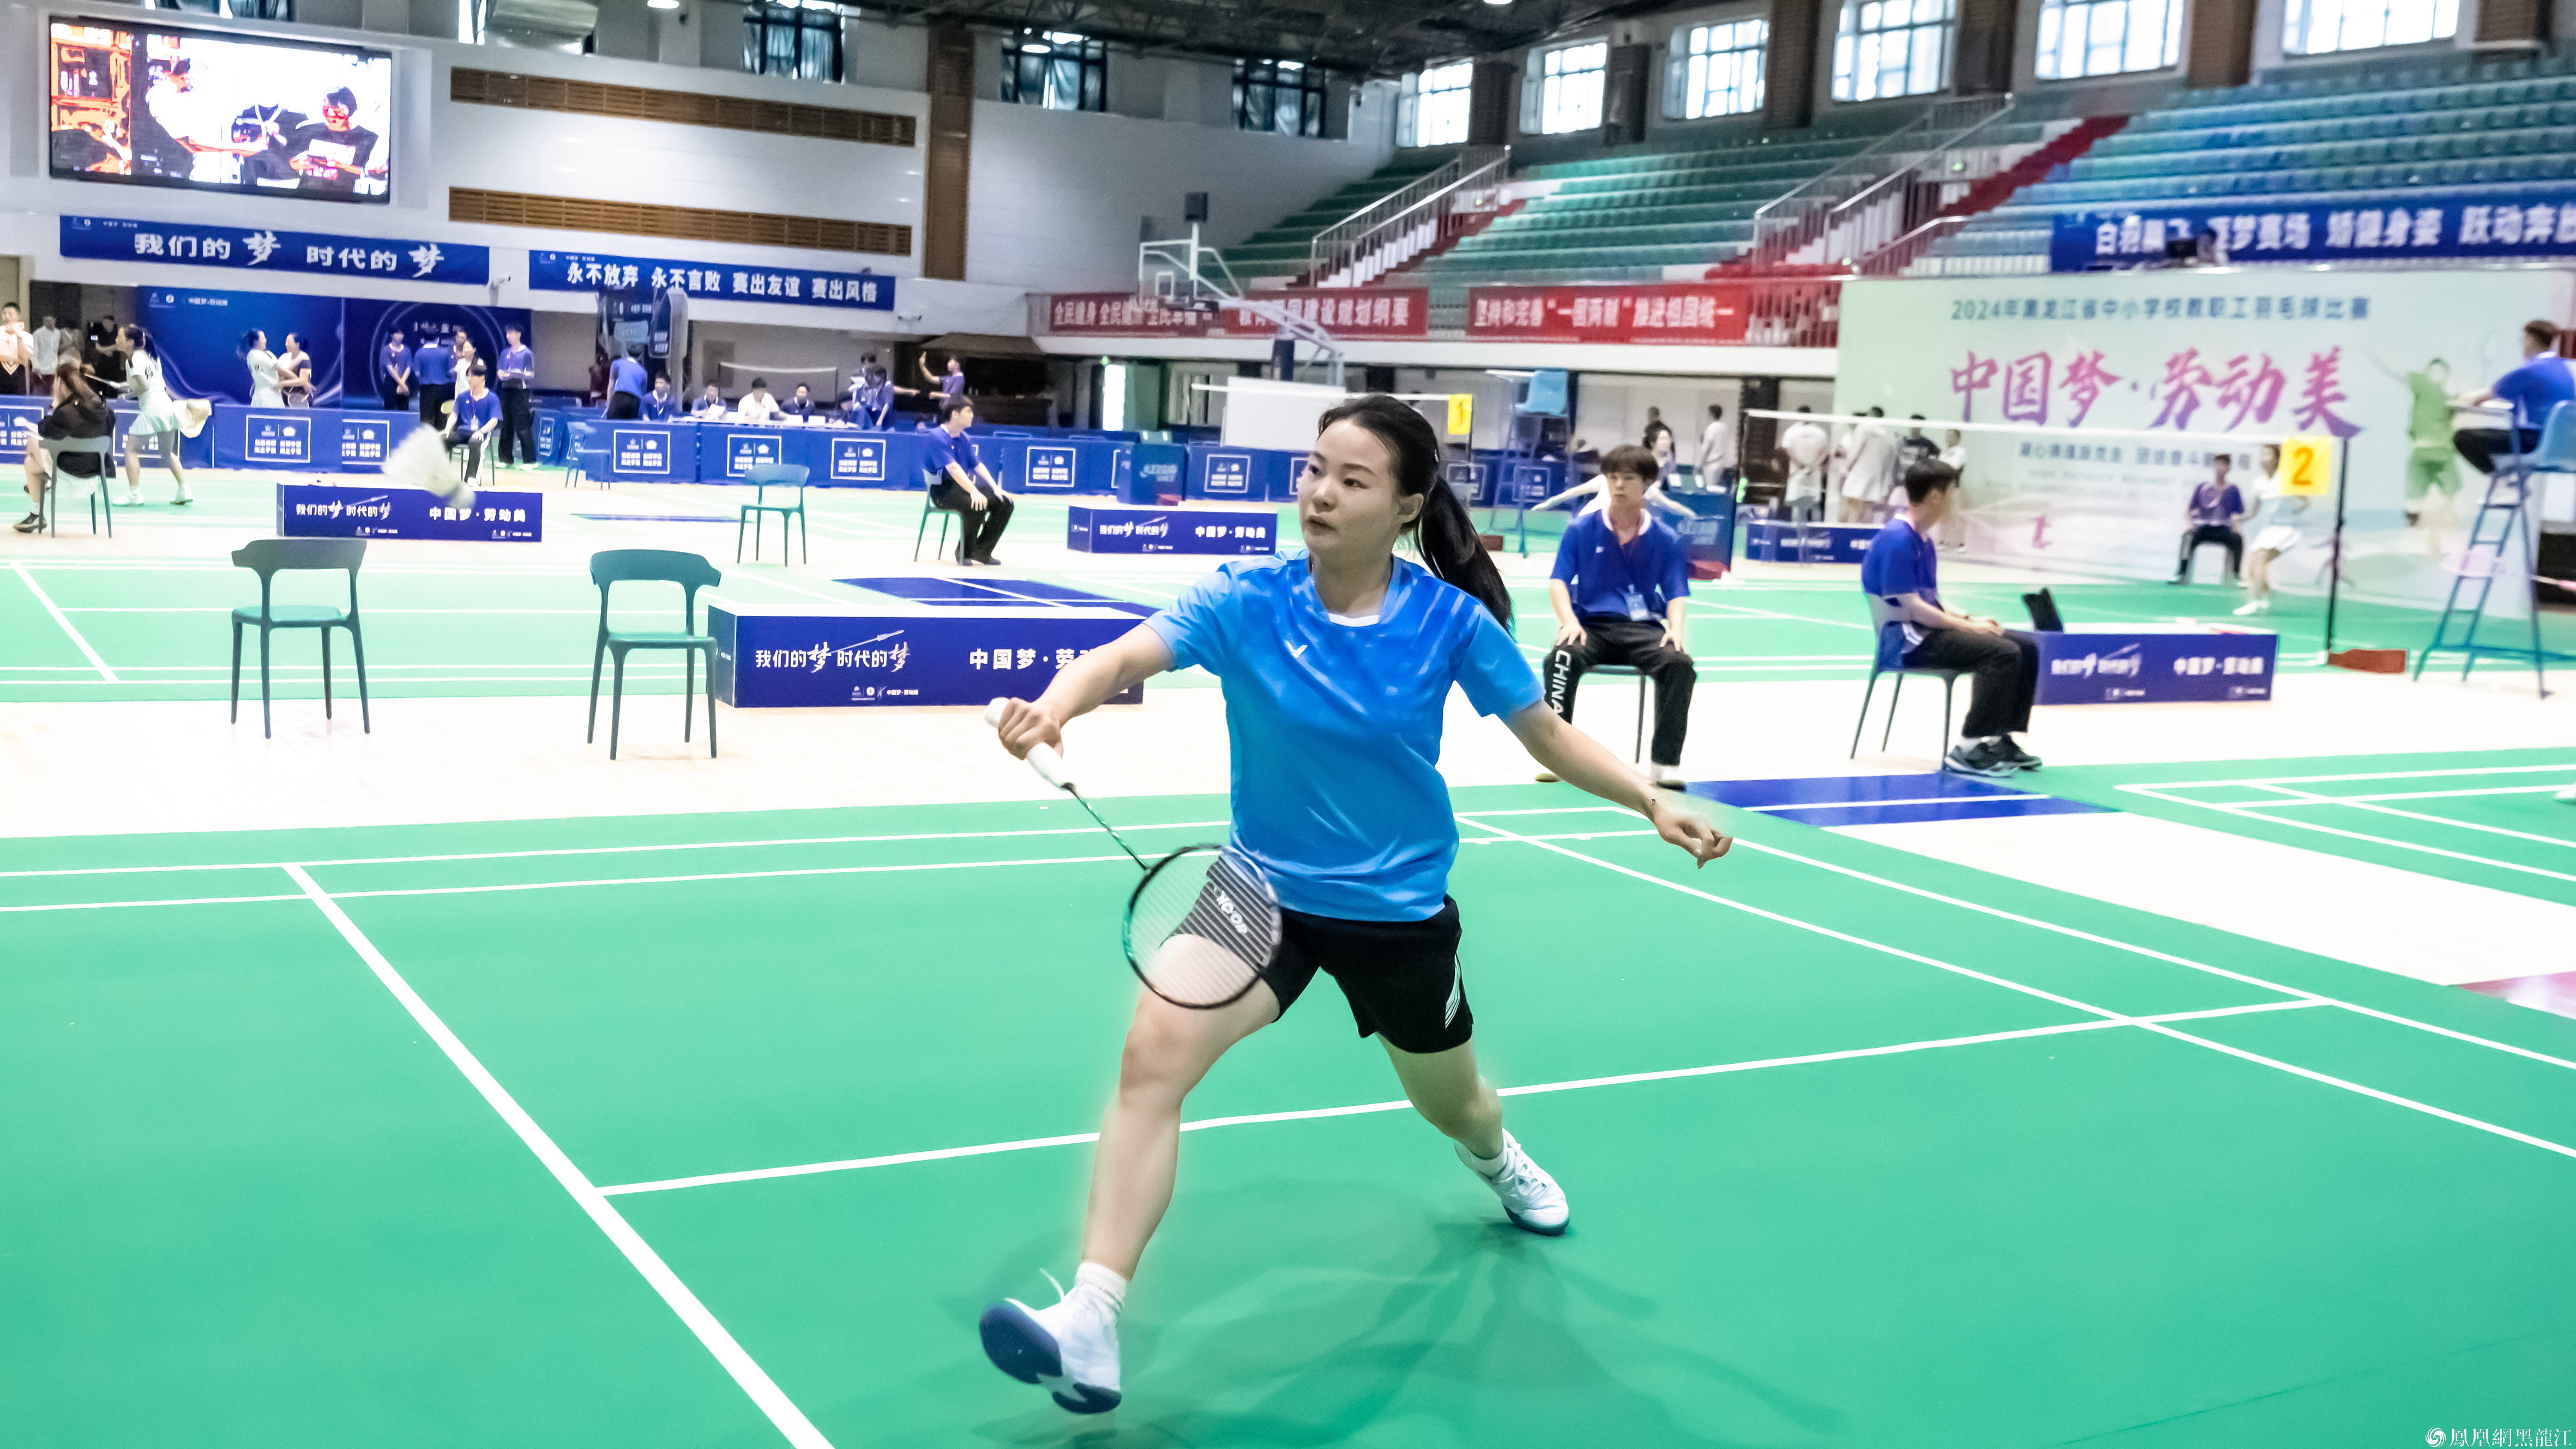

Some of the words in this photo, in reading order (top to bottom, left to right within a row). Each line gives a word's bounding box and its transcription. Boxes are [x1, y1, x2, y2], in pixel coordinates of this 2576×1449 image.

[134, 230, 281, 266] 我们的梦
[306, 243, 444, 278] 时代的梦
[567, 262, 639, 287] 永不放弃
[651, 266, 721, 292] 永不言败
[733, 272, 800, 298] 赛出友谊
[811, 277, 877, 303] 赛出风格
[1951, 346, 2366, 438] 中国梦·劳动美
[2292, 446, 2314, 486] 2
[296, 500, 344, 520] 我们的梦
[429, 506, 526, 523] 中国梦·劳动美
[755, 641, 832, 673] 我们的梦
[837, 641, 911, 673] 时代的梦
[970, 648, 1090, 670] 中国梦·劳
[1551, 650, 1571, 714] CHINA
